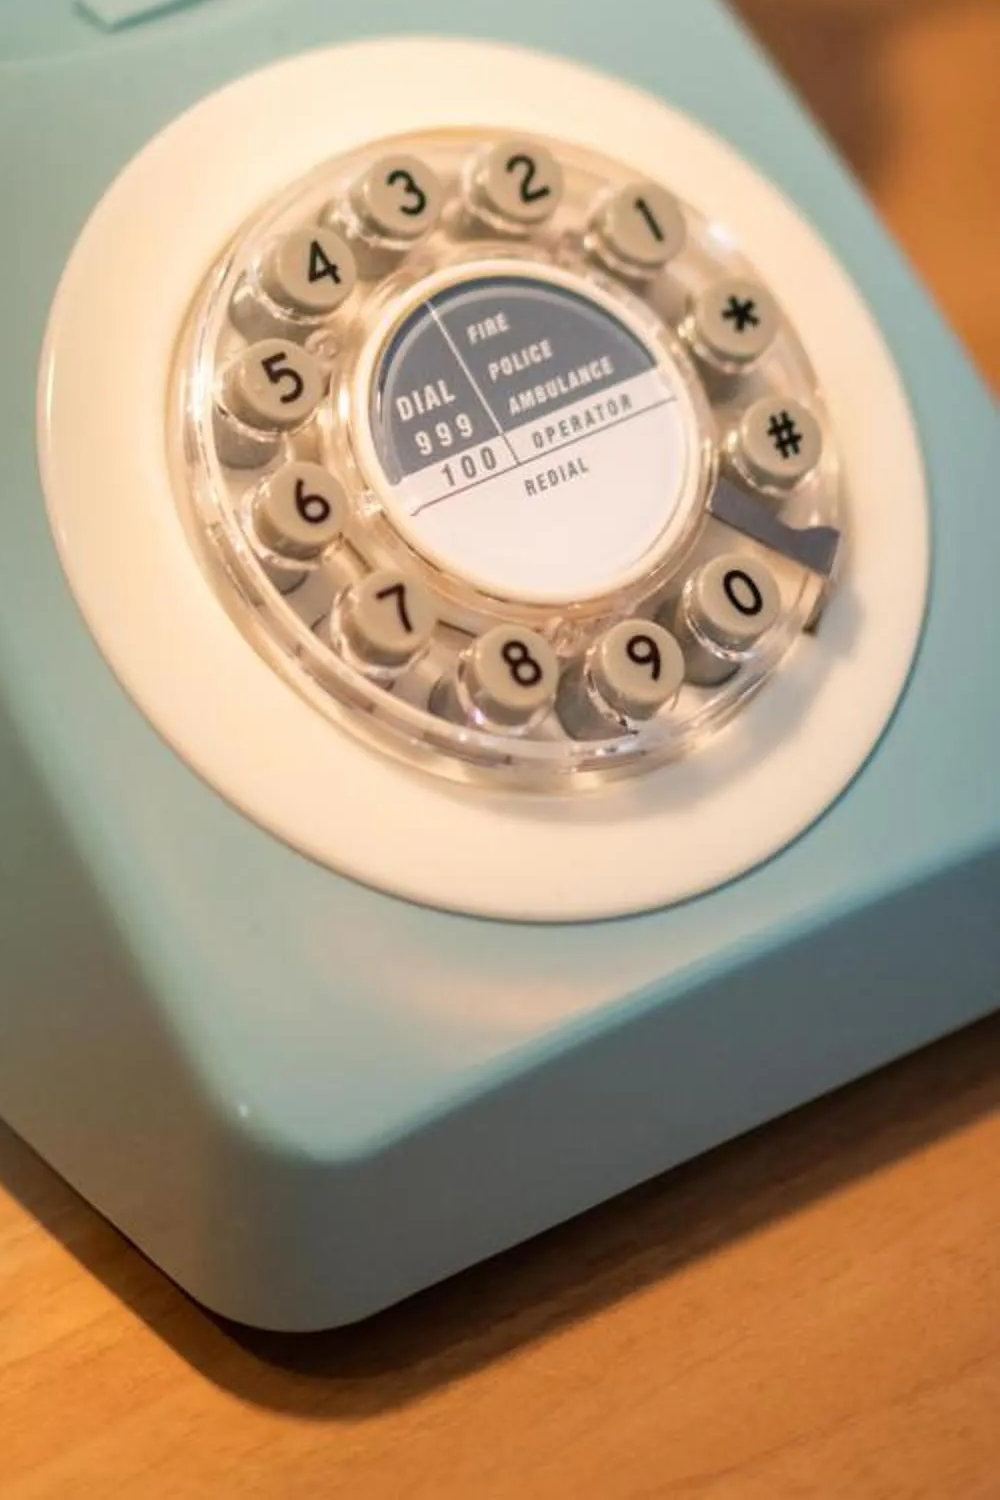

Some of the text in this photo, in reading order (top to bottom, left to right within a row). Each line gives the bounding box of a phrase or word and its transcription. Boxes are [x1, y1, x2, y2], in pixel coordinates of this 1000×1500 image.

[387, 169, 426, 215] 3
[505, 154, 550, 203] 2
[633, 197, 664, 242] 1
[307, 240, 341, 285] 4
[466, 312, 511, 344] FIRE
[260, 351, 304, 404] 5
[487, 339, 554, 382] POLICE
[396, 379, 456, 421] DIAL
[508, 356, 615, 416] AMBULANCE
[414, 413, 473, 456] 999
[440, 393, 633, 487] 100 OPERATOR
[524, 457, 590, 497] REDIAL
[294, 478, 330, 523] 6
[376, 583, 413, 633] 7
[722, 569, 763, 616] 0
[501, 640, 542, 687] 8
[626, 635, 661, 681] 9
